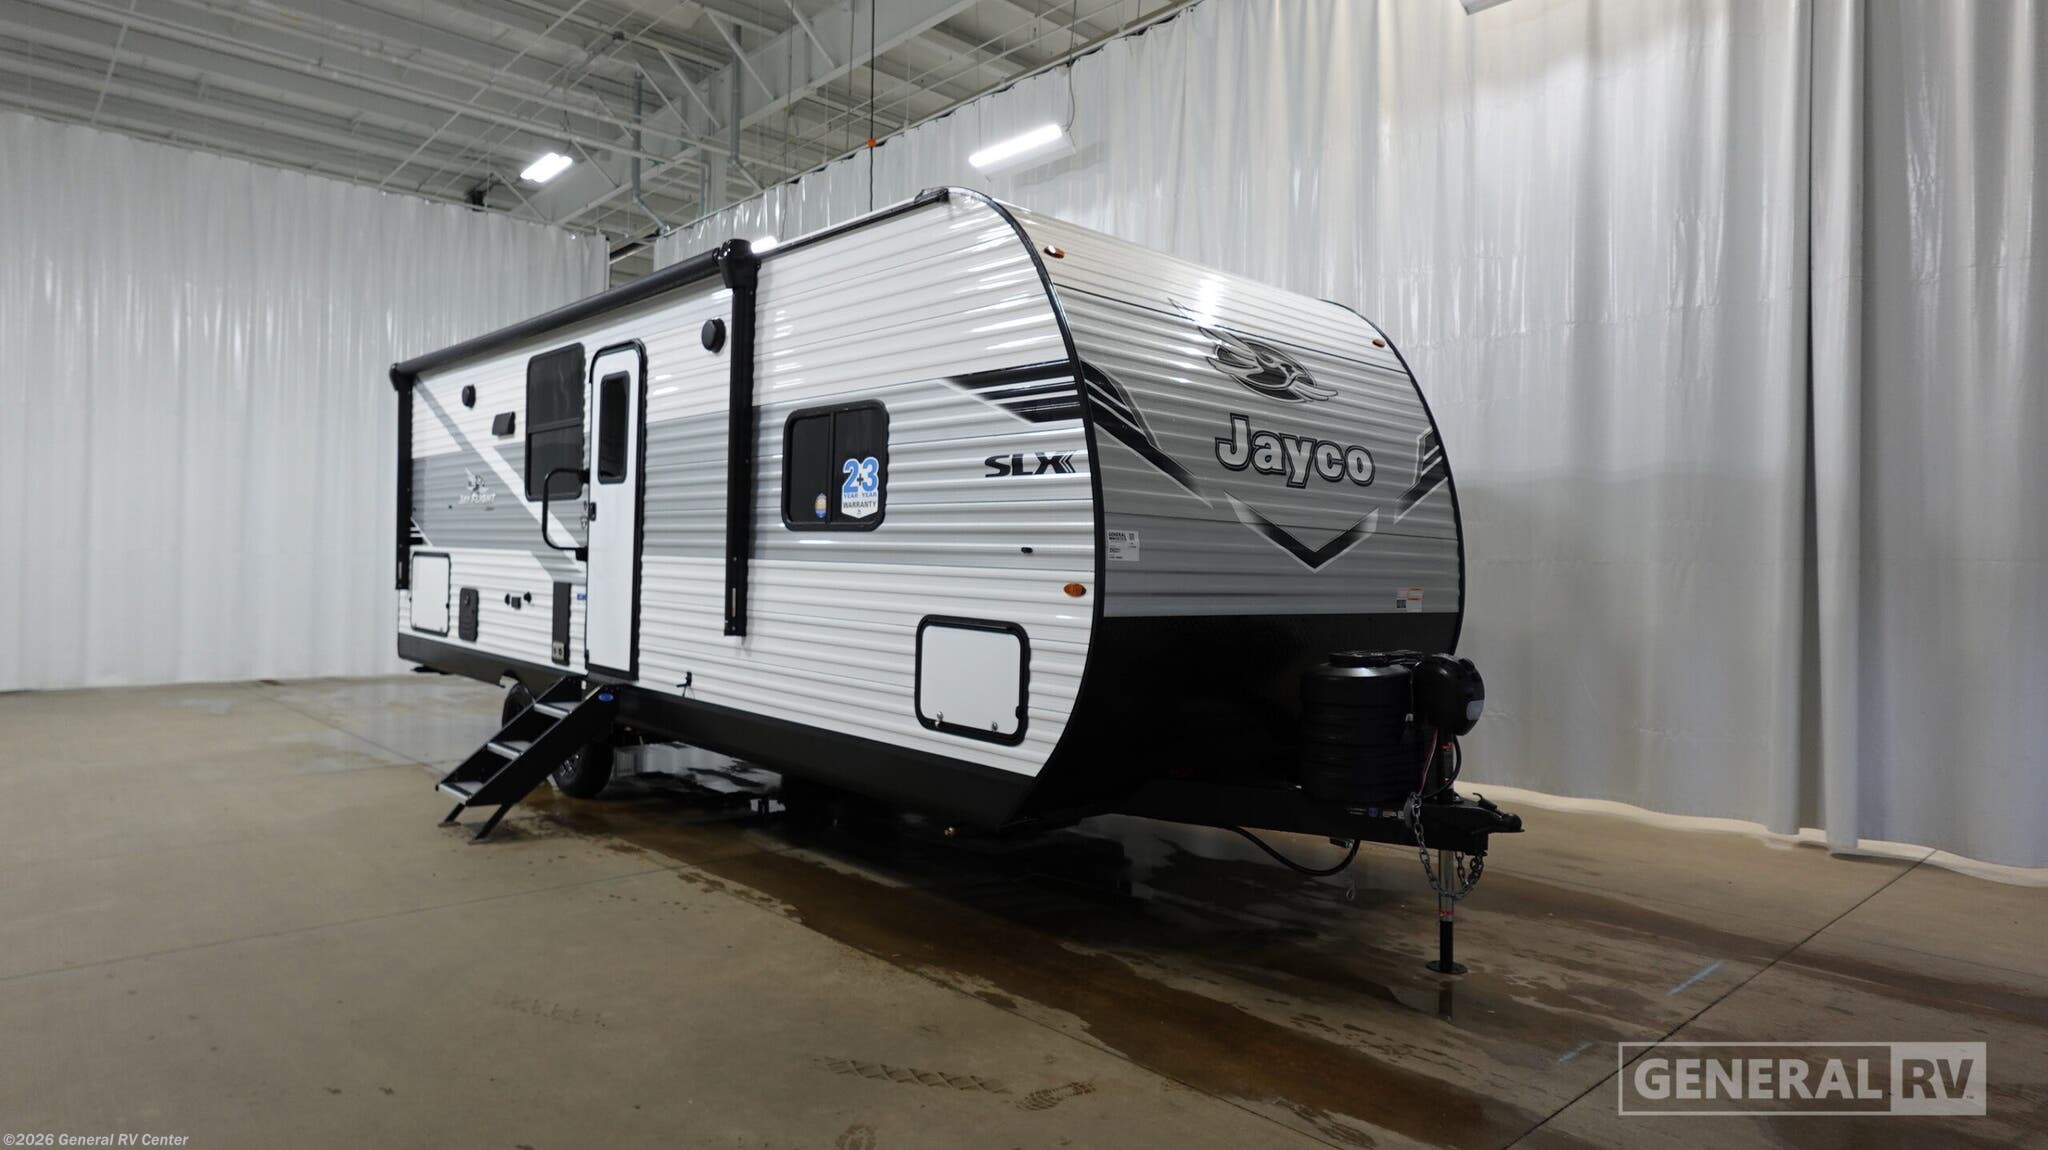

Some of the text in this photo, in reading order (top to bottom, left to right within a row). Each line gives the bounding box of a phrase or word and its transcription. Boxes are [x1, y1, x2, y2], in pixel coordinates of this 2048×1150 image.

[1214, 412, 1376, 489] Jayco
[985, 452, 1075, 478] SLX
[843, 501, 876, 509] WARRANTY
